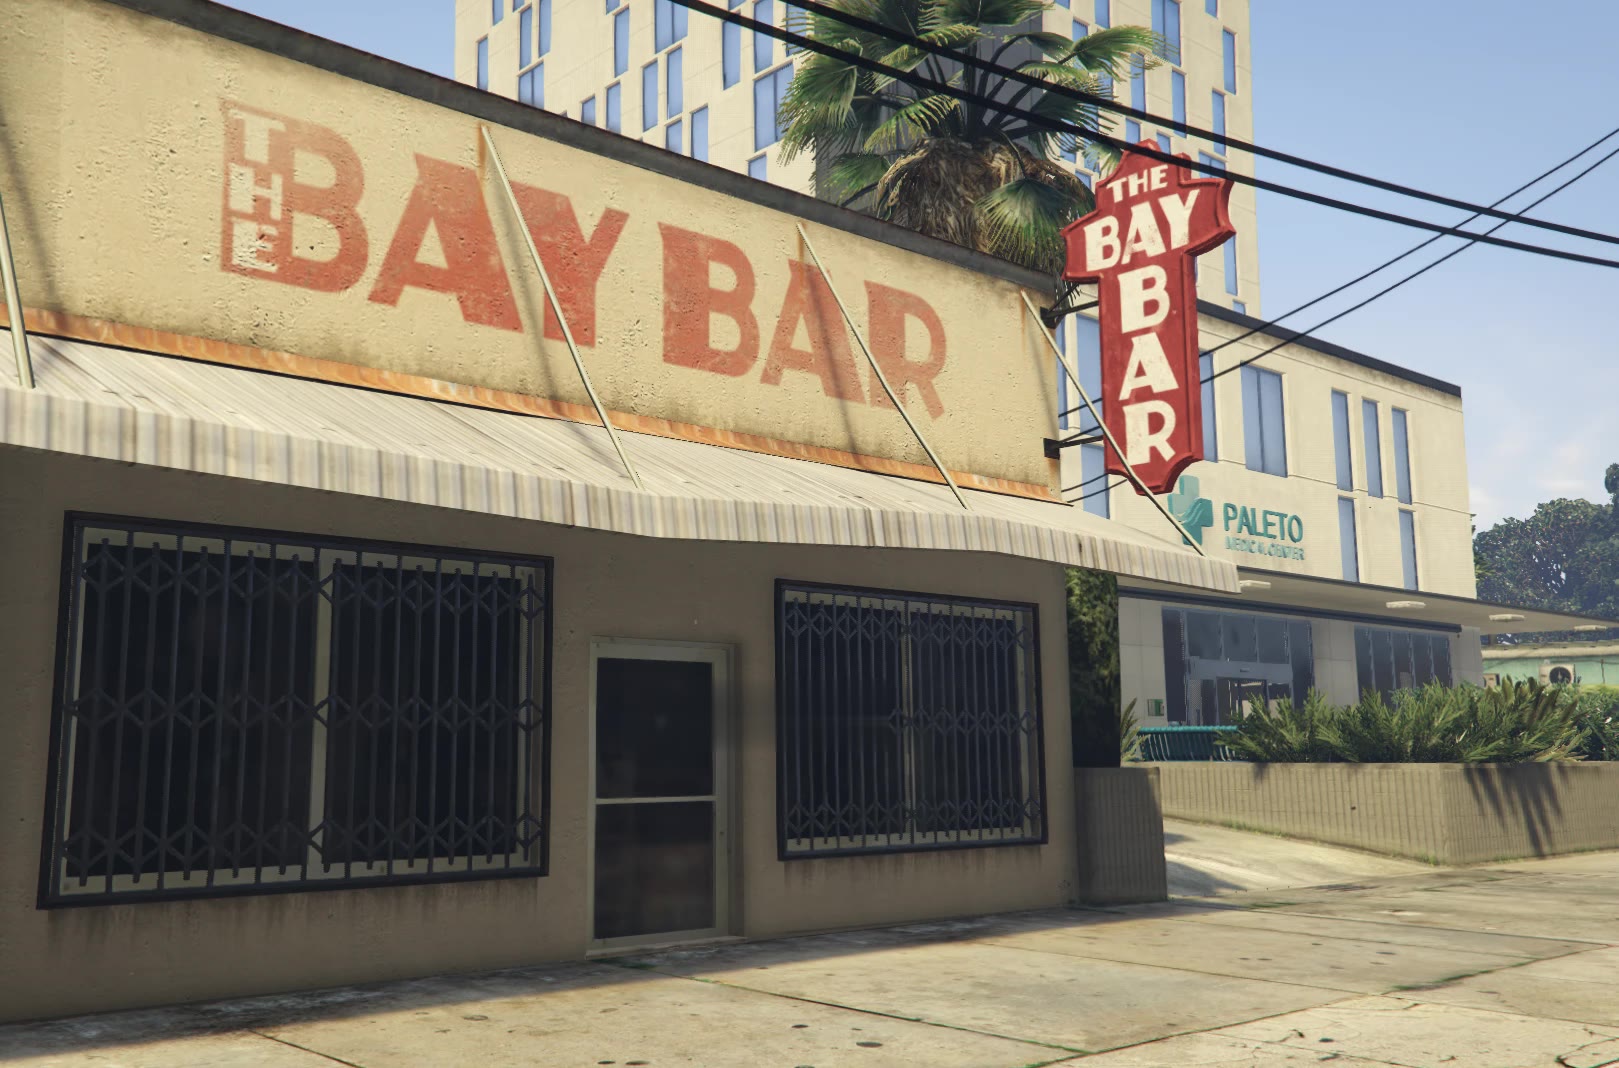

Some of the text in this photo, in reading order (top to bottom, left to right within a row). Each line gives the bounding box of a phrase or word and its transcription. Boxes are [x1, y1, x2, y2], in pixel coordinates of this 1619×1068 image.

[228, 108, 286, 273] THE
[1084, 189, 1200, 272] BAY
[1107, 164, 1169, 204] THE
[219, 101, 947, 420] BAY BAR
[1117, 264, 1180, 466] BAR
[1223, 502, 1303, 543] PALETO
